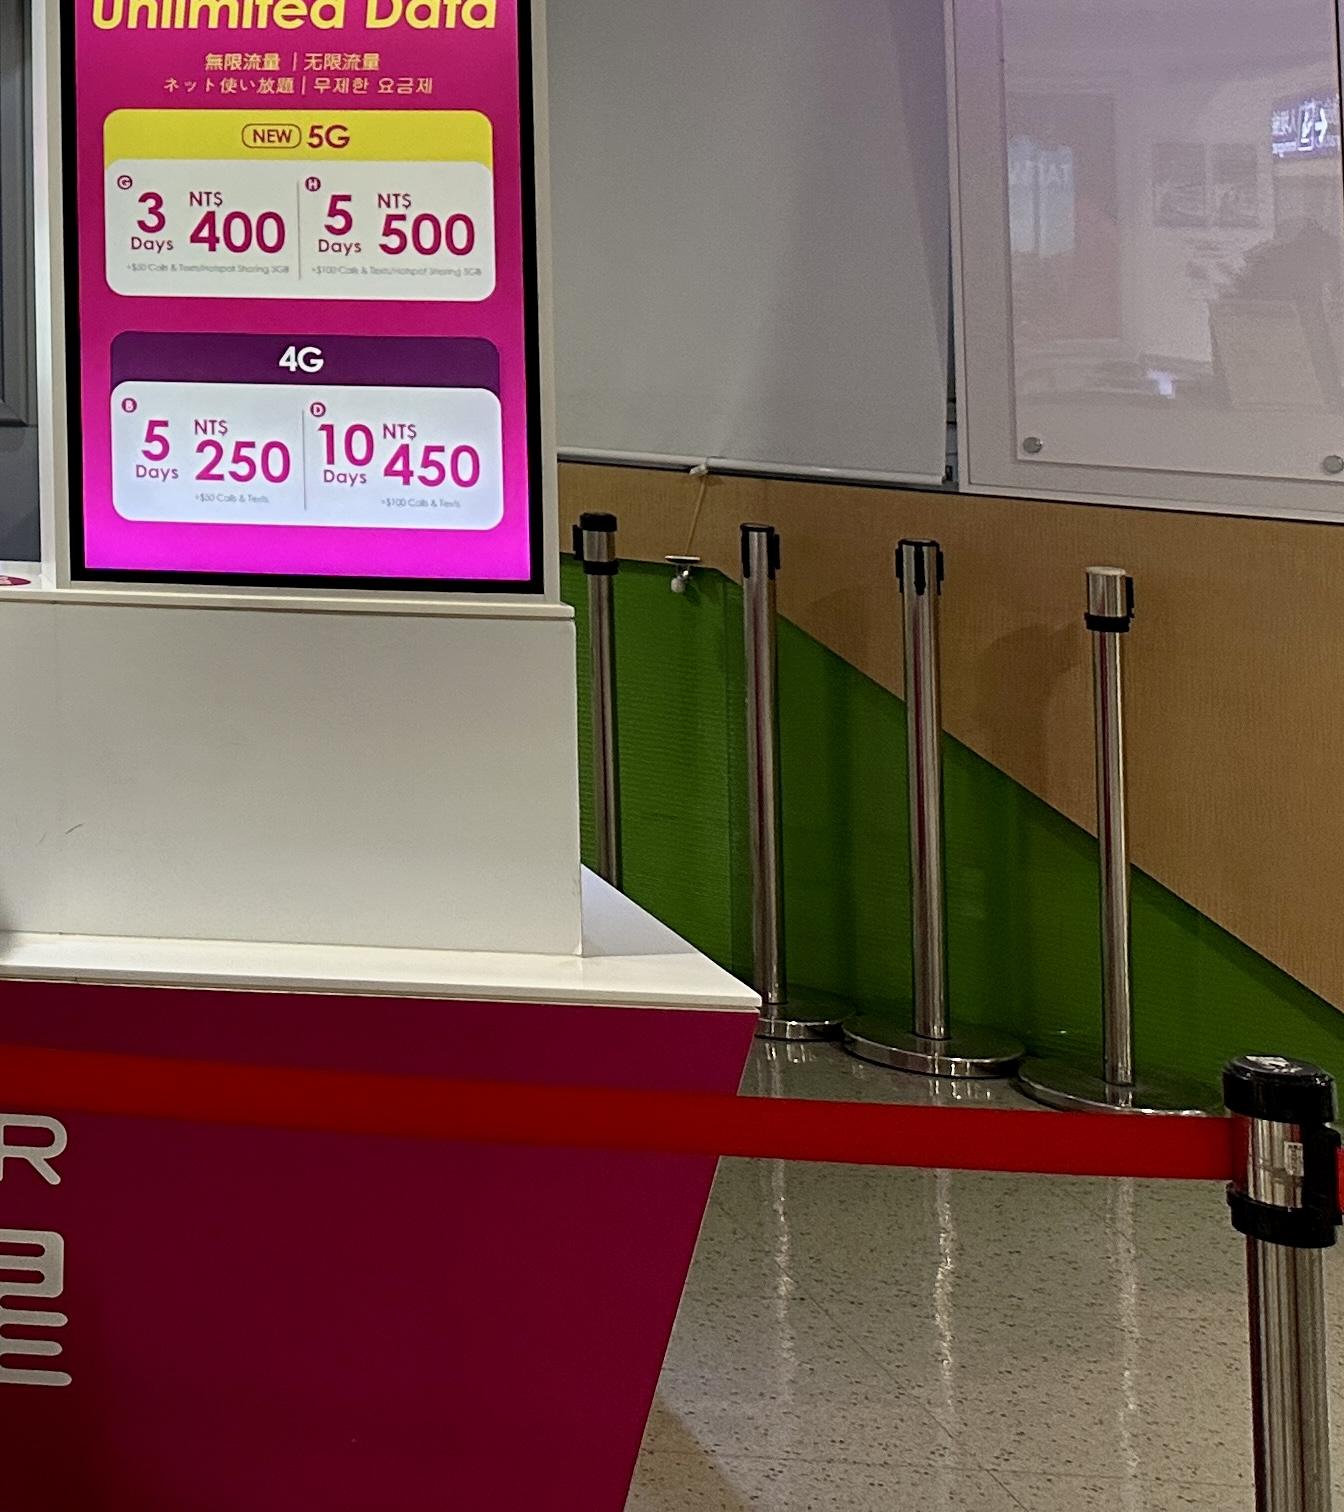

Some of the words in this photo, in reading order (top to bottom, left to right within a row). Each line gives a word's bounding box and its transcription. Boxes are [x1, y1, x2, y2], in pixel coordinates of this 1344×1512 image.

[204, 52, 281, 71] 無限流量
[304, 52, 380, 71] 无限流量
[163, 77, 295, 95] ネット使い放題
[313, 77, 369, 95] 무제한
[377, 77, 433, 95] 요금제
[251, 128, 293, 145] NEW
[307, 124, 351, 149] 5G
[189, 191, 223, 207] NT$
[377, 193, 411, 209] NT$
[136, 192, 166, 233] 3
[324, 194, 353, 236] 5
[189, 210, 286, 254] 400
[379, 213, 475, 255] 500
[131, 236, 174, 254] Days
[318, 239, 362, 256] Days
[278, 345, 324, 372] 4G
[194, 419, 228, 436] NT$
[383, 423, 417, 441] NT$
[141, 419, 171, 461] 5
[318, 423, 374, 466] 10
[194, 440, 291, 484] 250
[383, 443, 481, 488] 450
[135, 464, 179, 482] Days
[323, 469, 367, 487] Days
